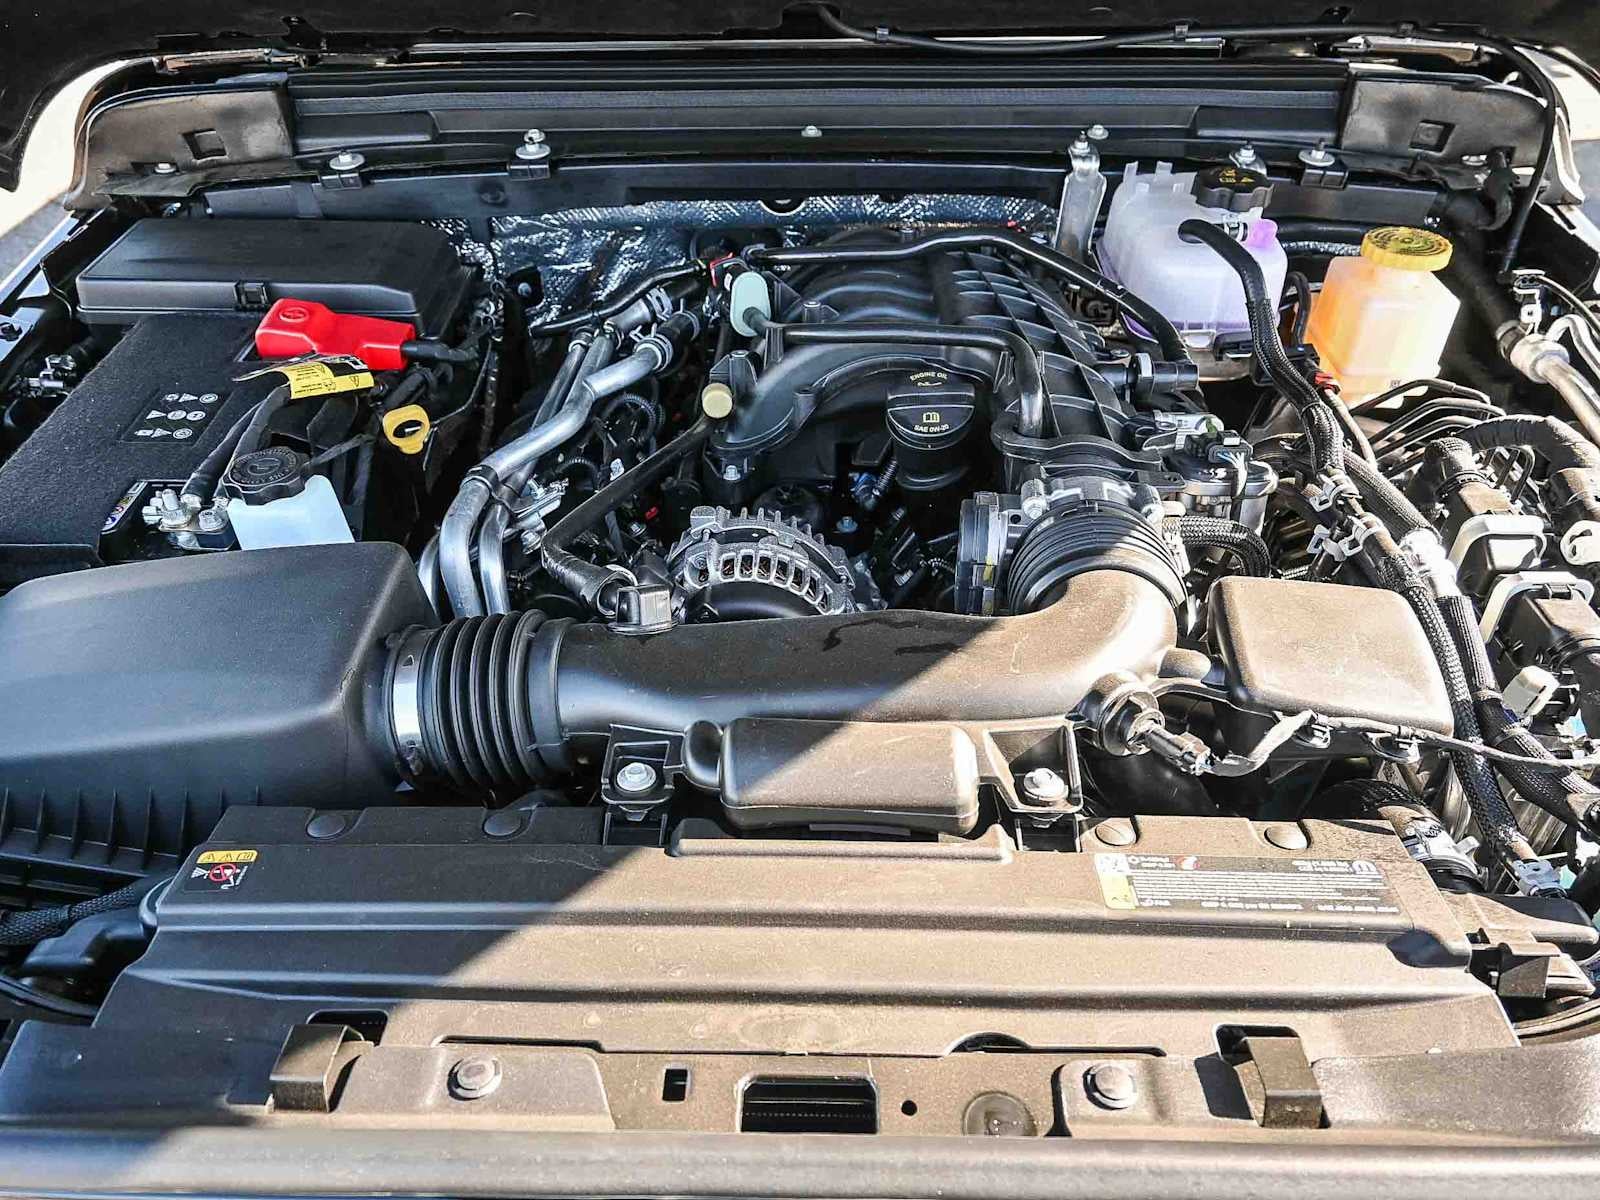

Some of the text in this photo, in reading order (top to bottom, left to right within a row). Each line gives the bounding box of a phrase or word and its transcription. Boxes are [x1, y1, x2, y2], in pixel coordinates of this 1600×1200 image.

[909, 371, 948, 381] ENGINE OIL
[913, 424, 928, 433] SAE
